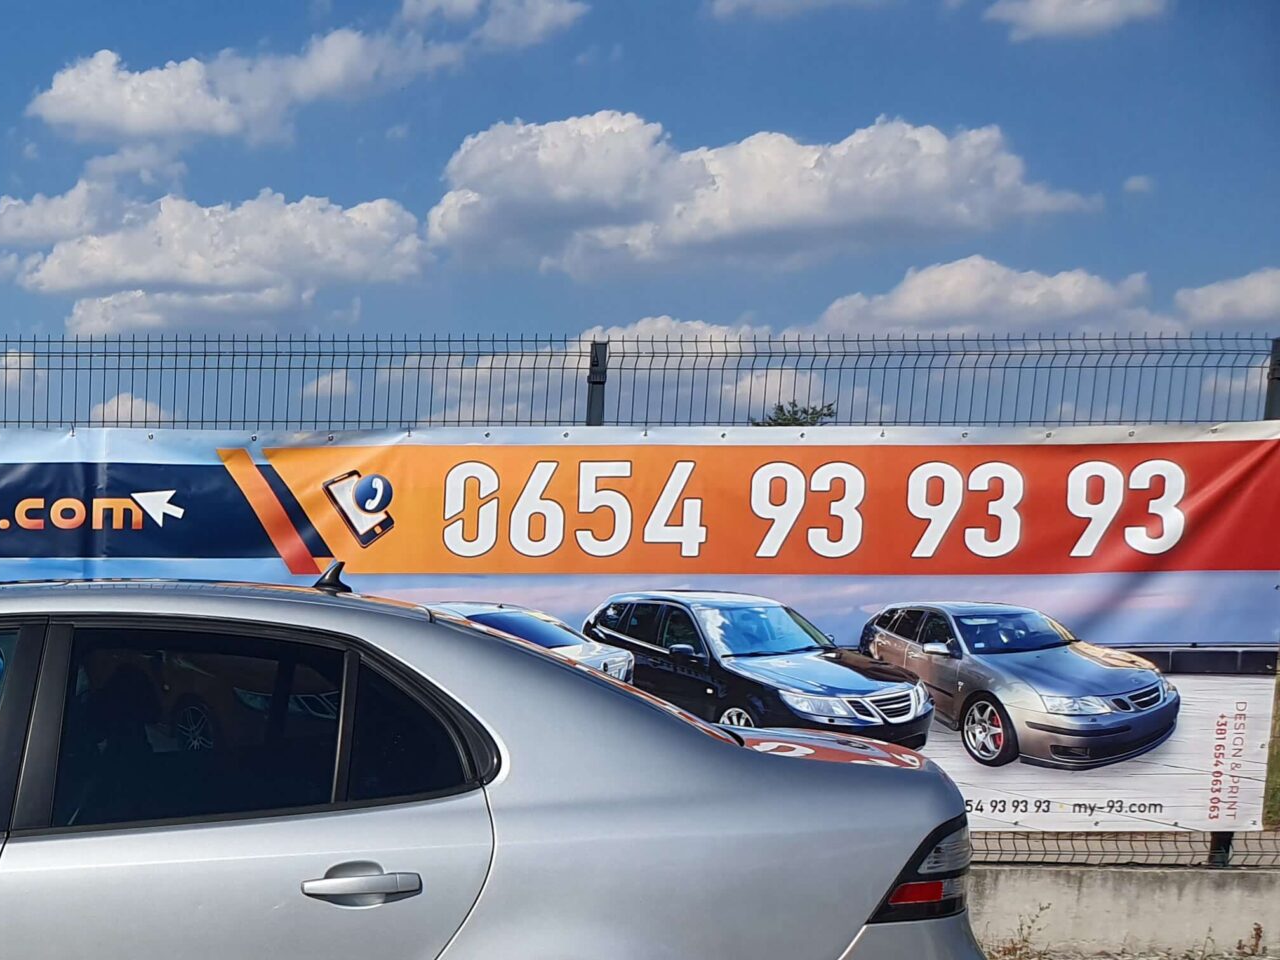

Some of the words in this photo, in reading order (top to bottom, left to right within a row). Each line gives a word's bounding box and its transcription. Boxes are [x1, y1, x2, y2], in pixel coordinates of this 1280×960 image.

[442, 459, 708, 558] 0654
[749, 460, 866, 558] 93
[906, 460, 1024, 558] 93
[1065, 459, 1187, 557] 93
[1232, 702, 1247, 757] DESIGN
[1213, 744, 1226, 767] 654
[1230, 762, 1242, 771] &
[1210, 770, 1223, 794] 063
[965, 800, 984, 813] 54
[990, 800, 1006, 813] 93
[1012, 800, 1028, 813] 93
[1034, 800, 1051, 813] 93
[1072, 800, 1163, 816] my-93.com
[1208, 796, 1221, 820] 063
[1225, 776, 1240, 820] PRINT
